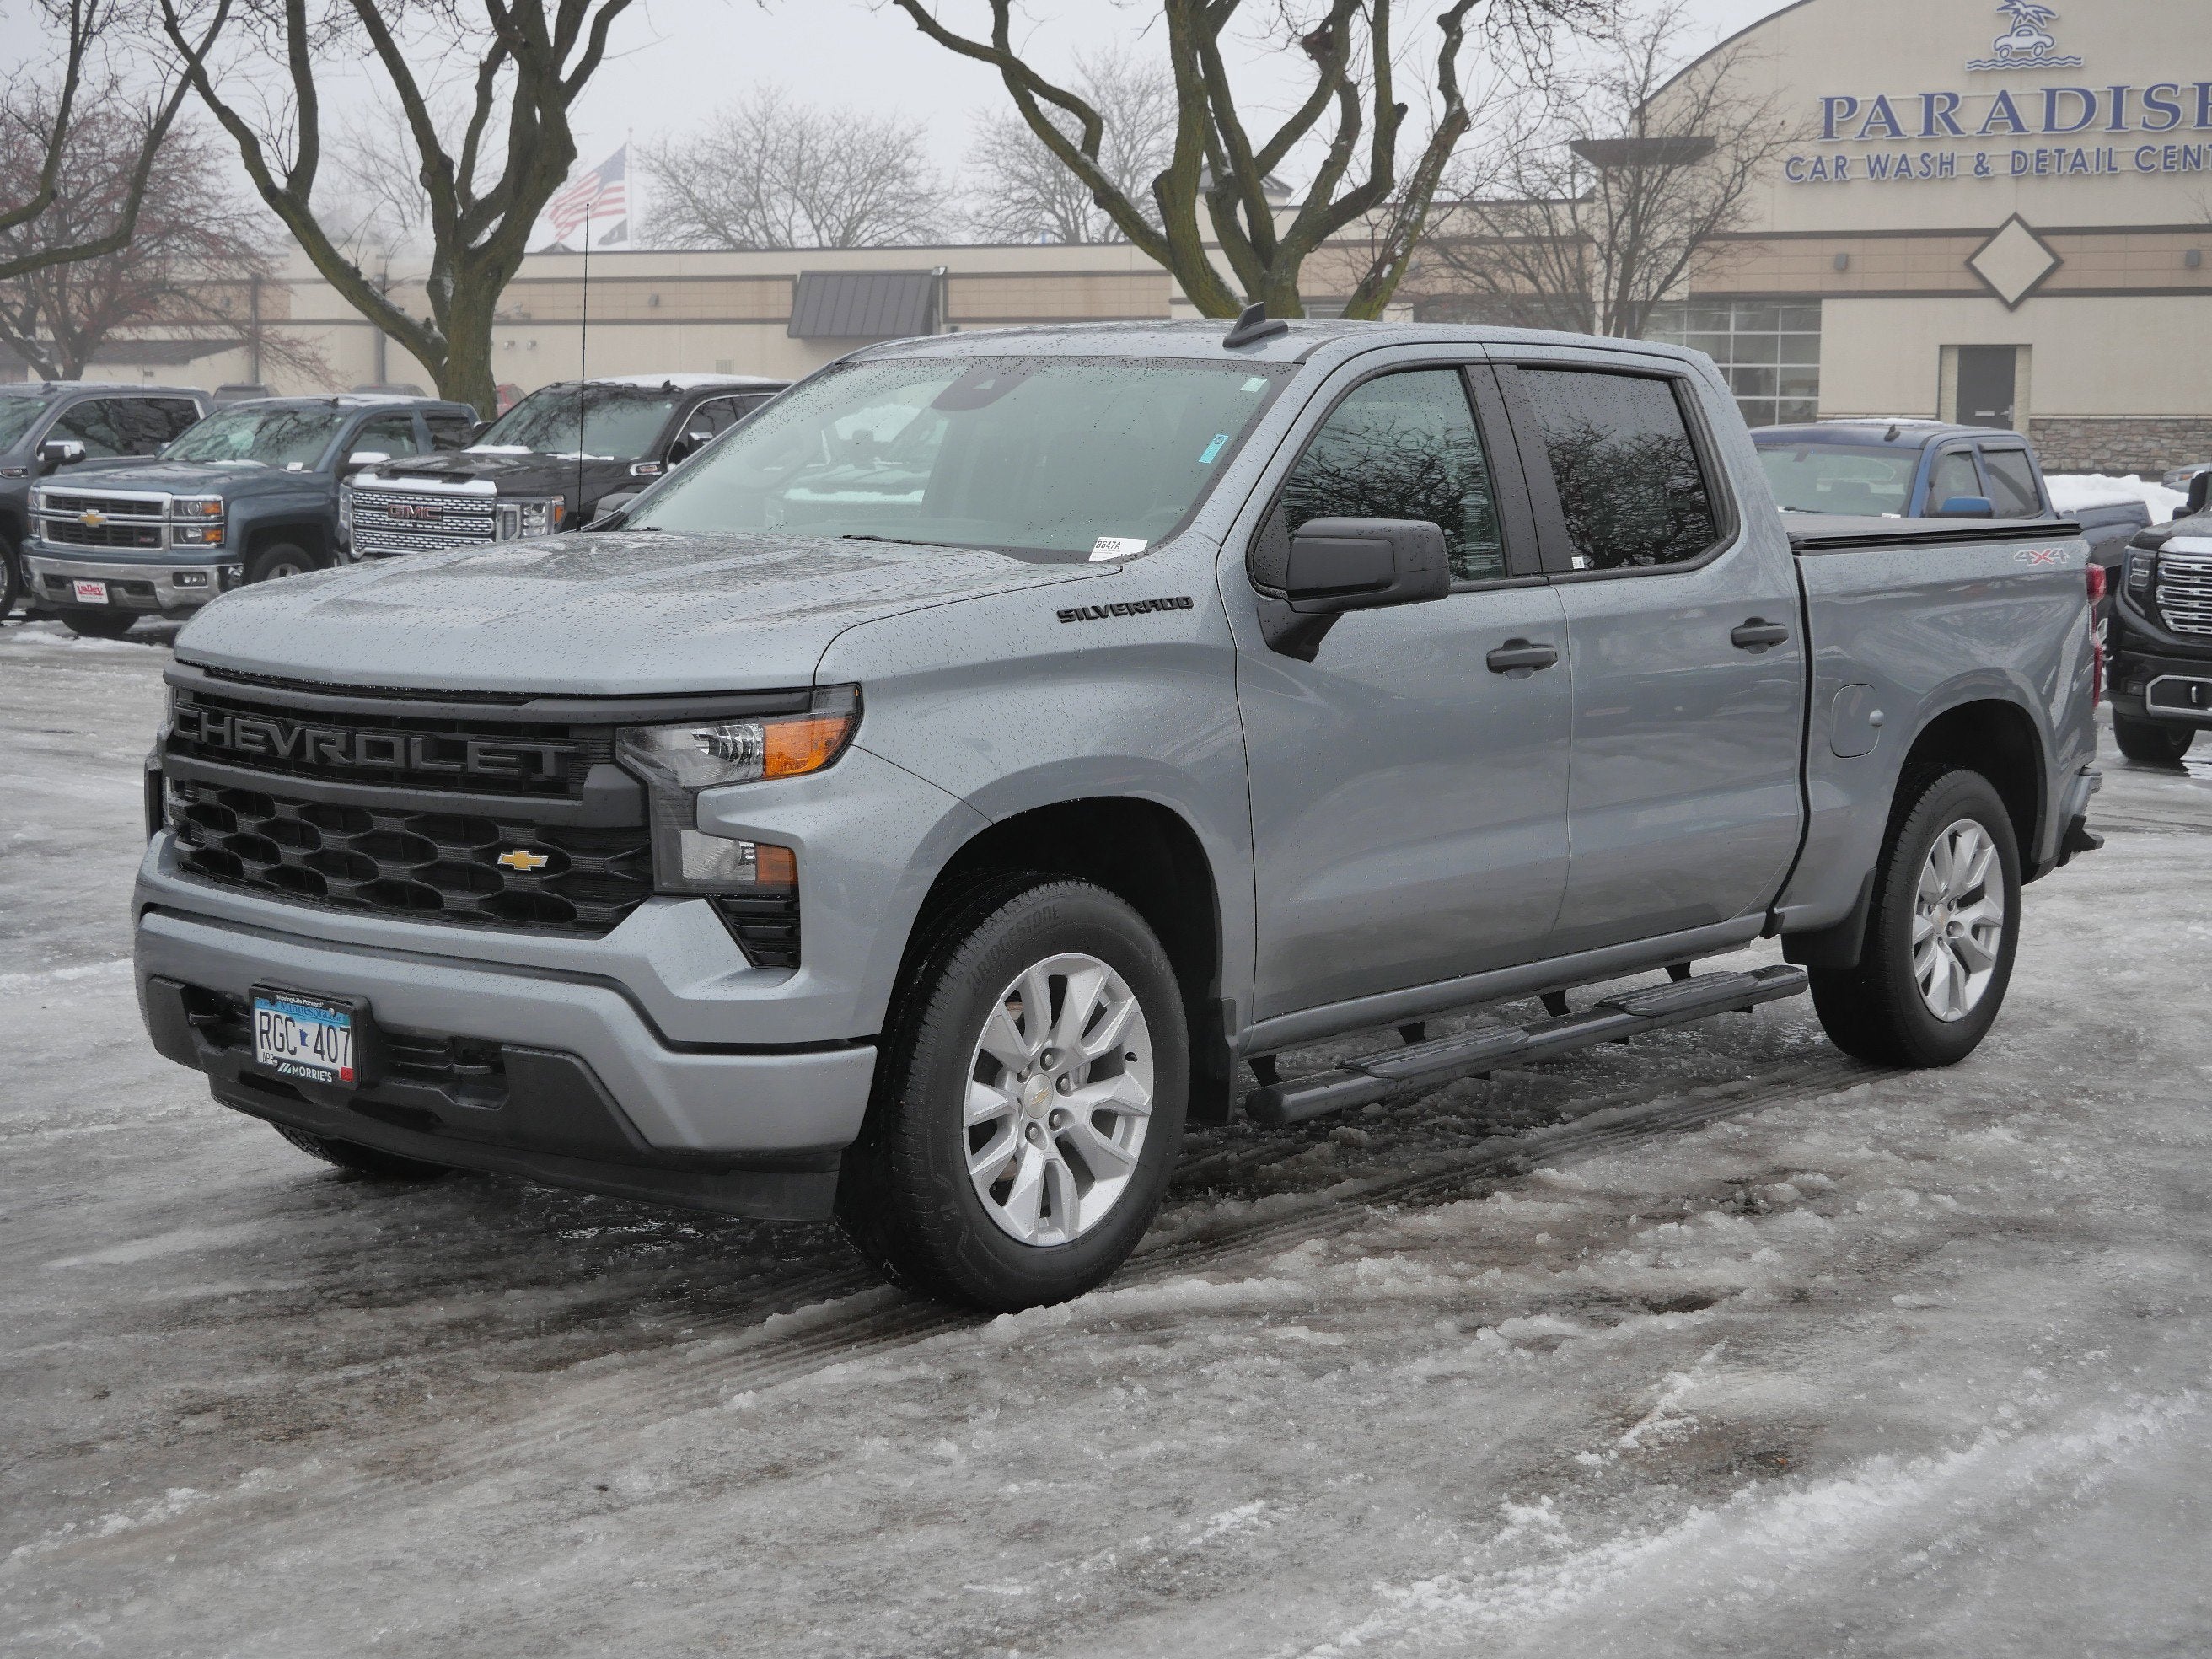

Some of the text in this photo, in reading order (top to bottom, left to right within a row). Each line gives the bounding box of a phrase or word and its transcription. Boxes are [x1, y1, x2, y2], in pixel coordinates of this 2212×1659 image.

[1817, 82, 2212, 141] PARADISE
[1785, 154, 1848, 182] CAR
[1866, 152, 1955, 179] WASH
[1973, 152, 1990, 176] &
[2011, 147, 2118, 175] DETAIL
[388, 504, 443, 520] GMC
[1056, 595, 1195, 624] SILVERADO
[173, 706, 582, 779] CHEVROLET
[259, 1010, 352, 1066] RGC 407
[292, 1066, 333, 1083] MORRIE'S
